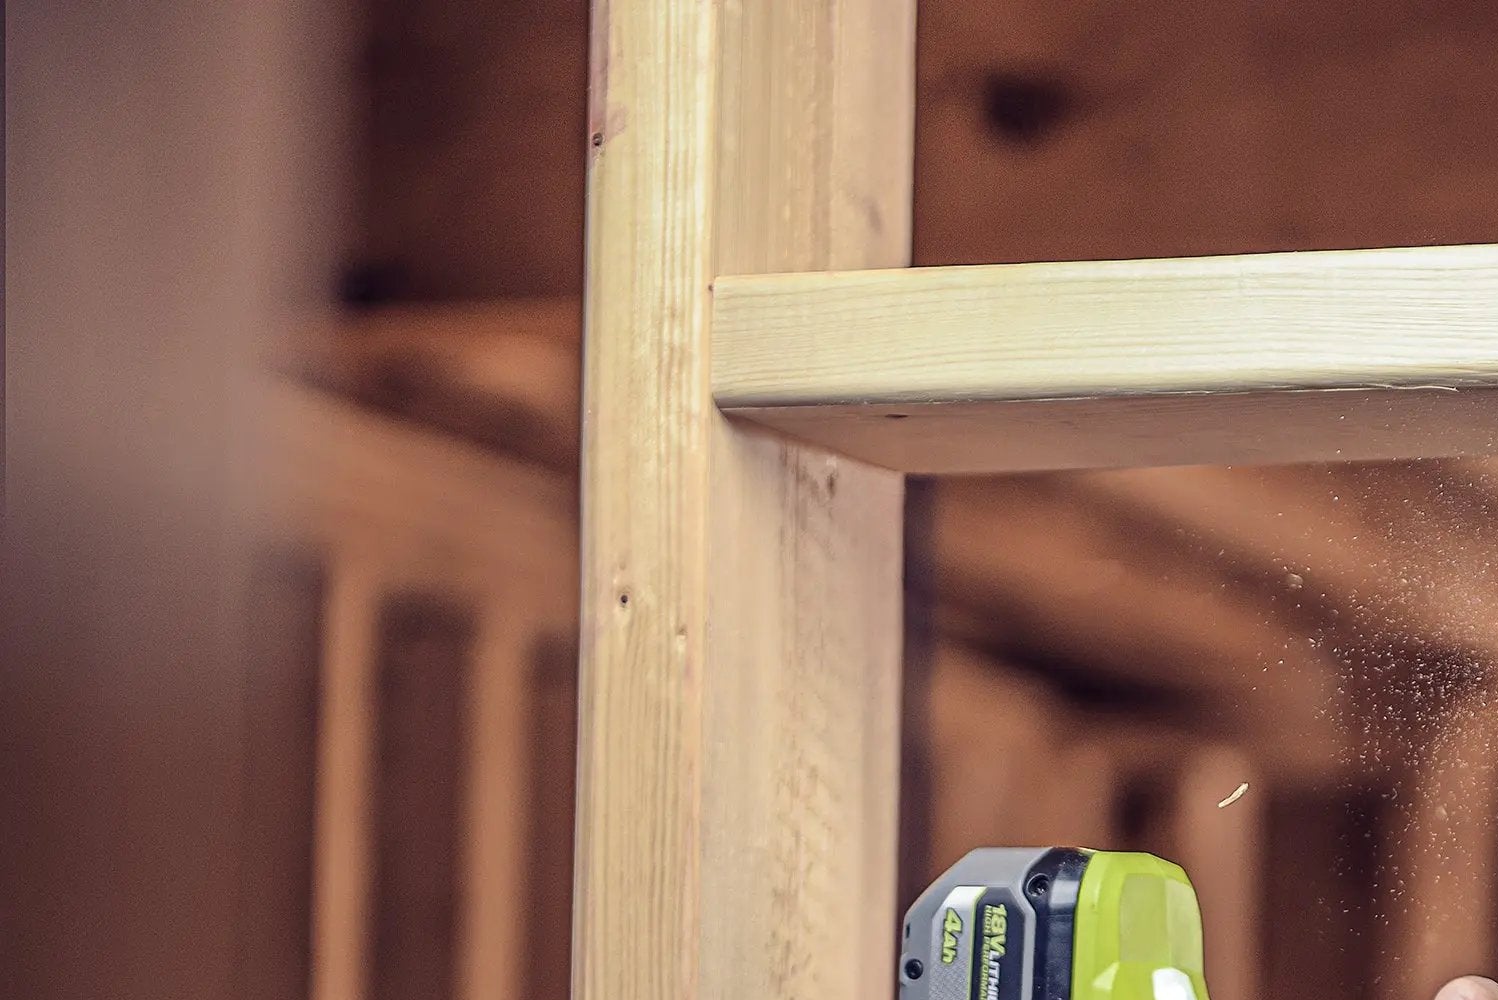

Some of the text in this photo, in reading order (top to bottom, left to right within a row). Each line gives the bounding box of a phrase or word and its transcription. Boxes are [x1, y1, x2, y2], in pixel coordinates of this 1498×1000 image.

[942, 907, 963, 964] 4Ah
[984, 905, 992, 936] HIGH
[990, 904, 1007, 956] 18V
